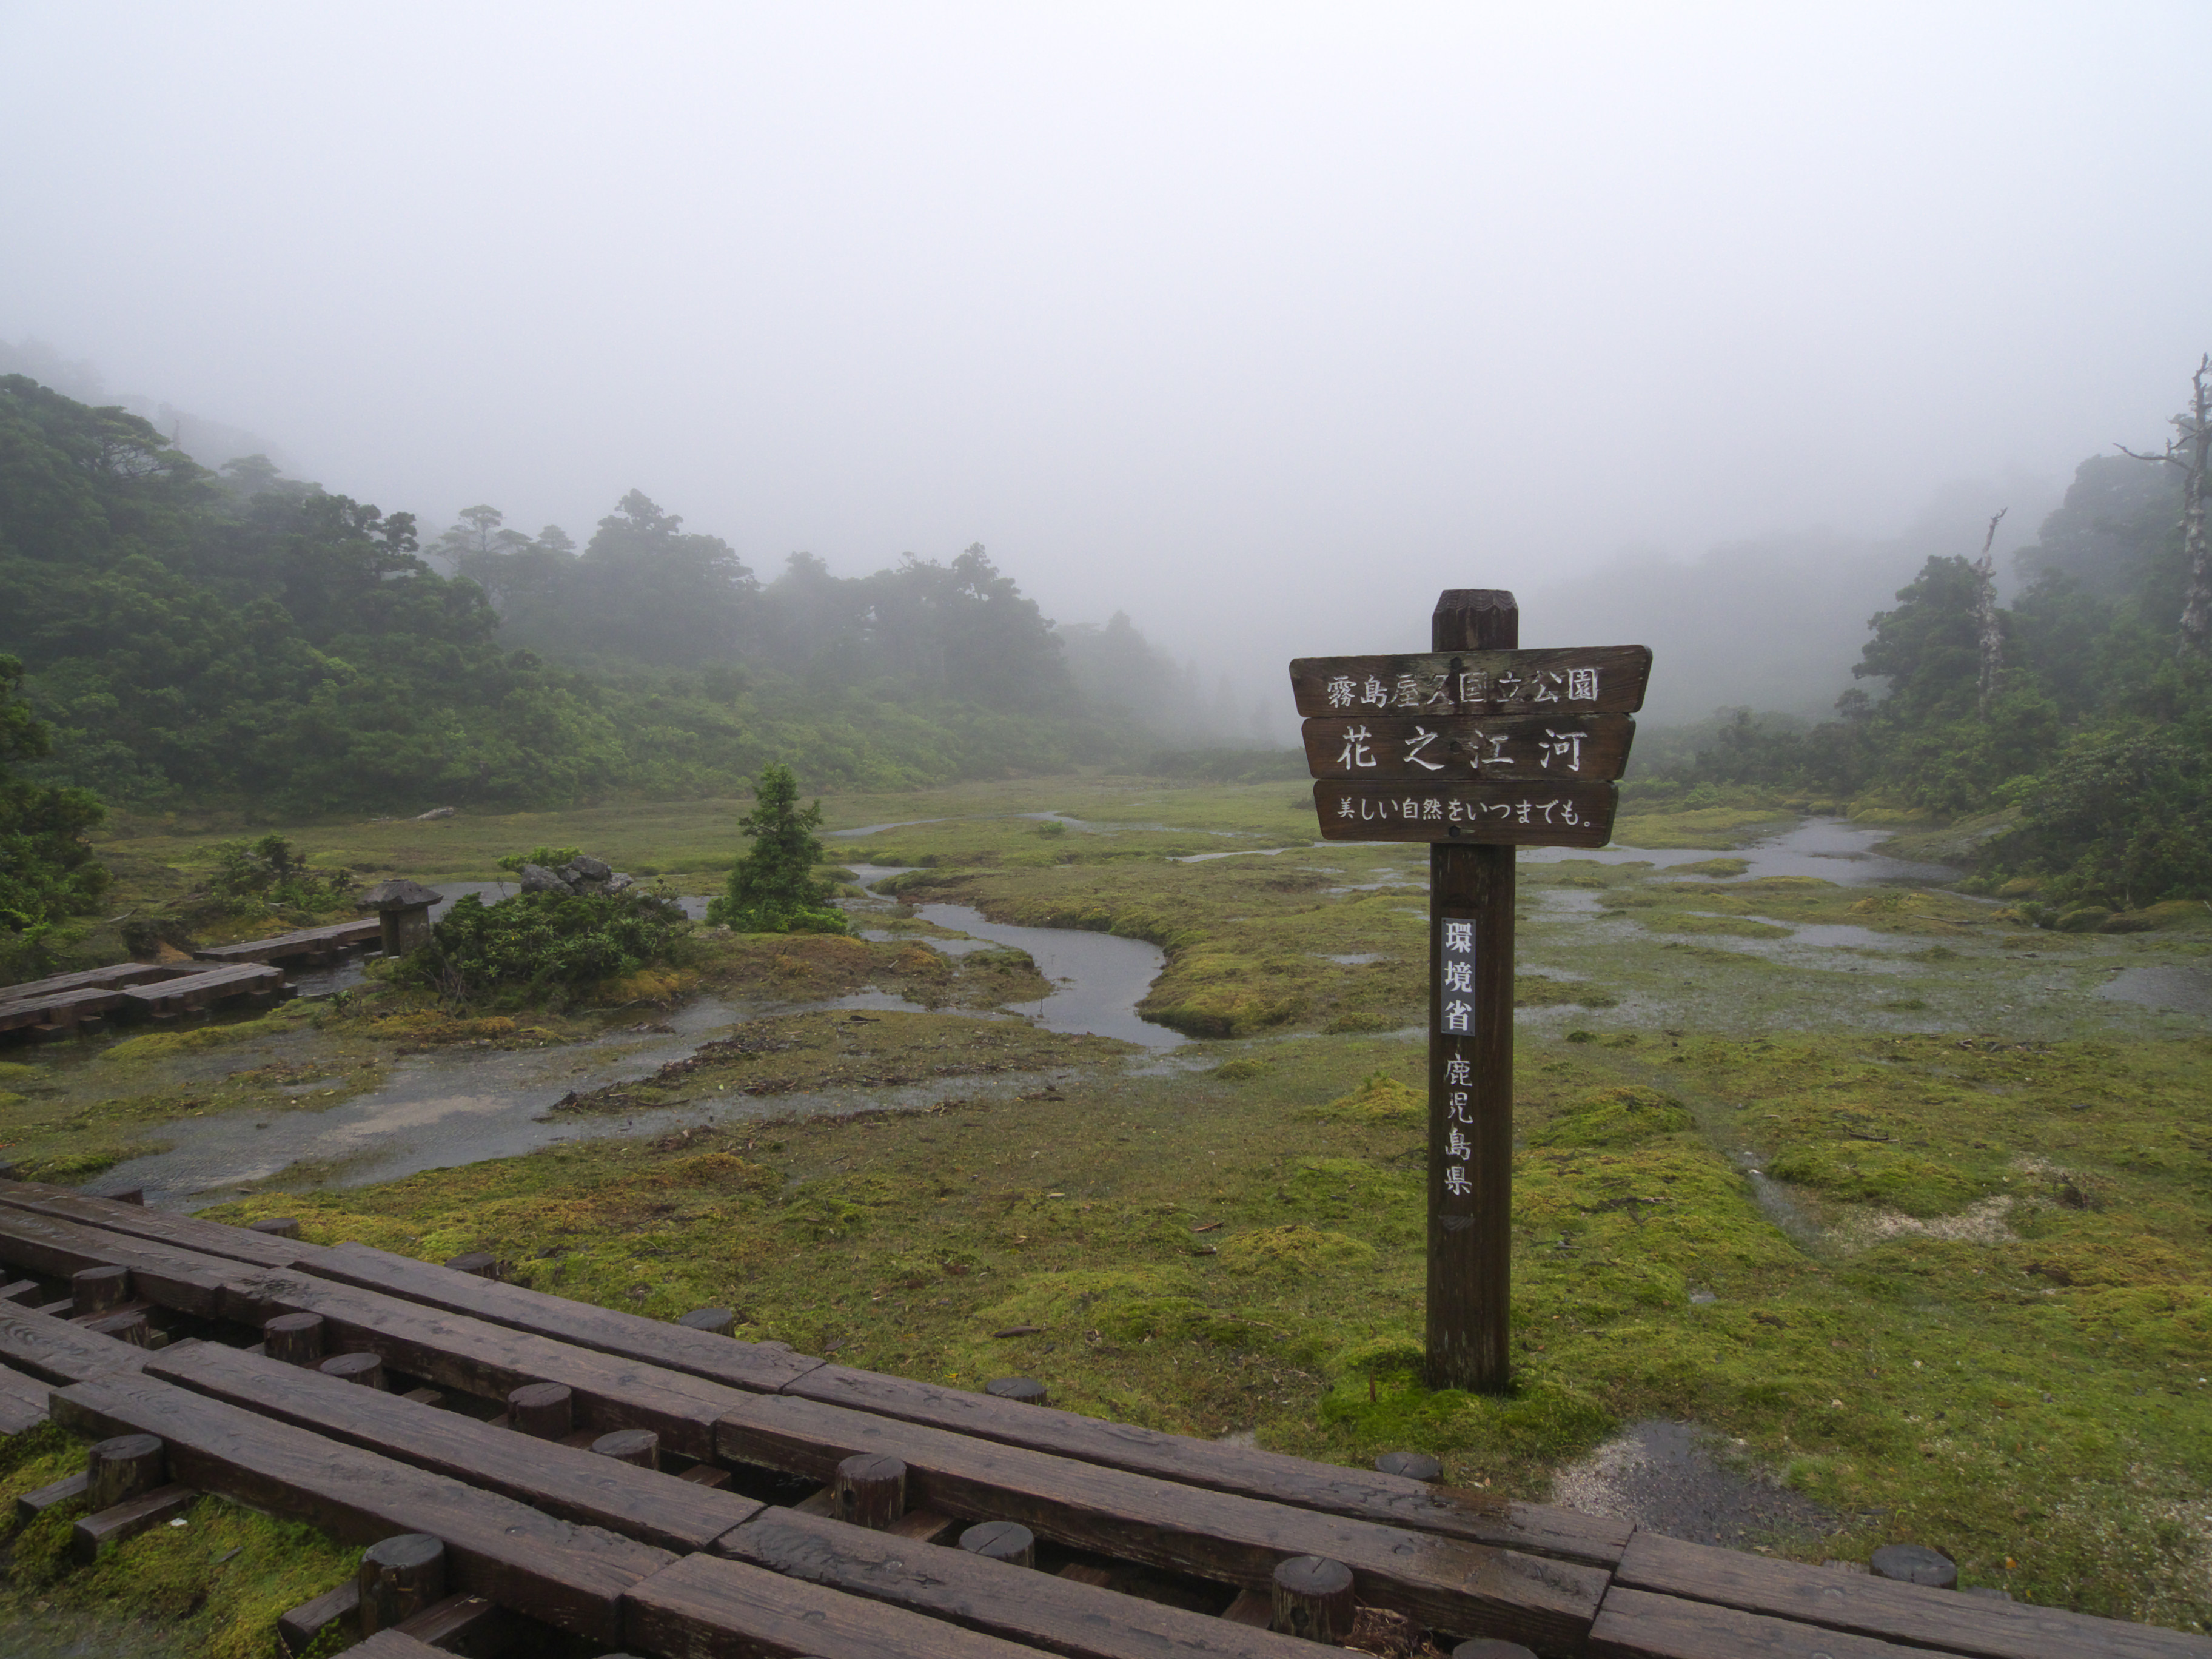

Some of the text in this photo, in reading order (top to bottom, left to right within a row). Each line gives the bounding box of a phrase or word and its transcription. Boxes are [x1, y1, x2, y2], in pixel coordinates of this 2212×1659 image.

[1327, 668, 1599, 708] 霧島屋久国立公園
[1336, 725, 1588, 771] 花之江河
[1337, 797, 1591, 828] 美しい自然をいつまでも。
[1444, 922, 1473, 1032] 環境省
[1443, 1053, 1473, 1196] 鹿児島県
